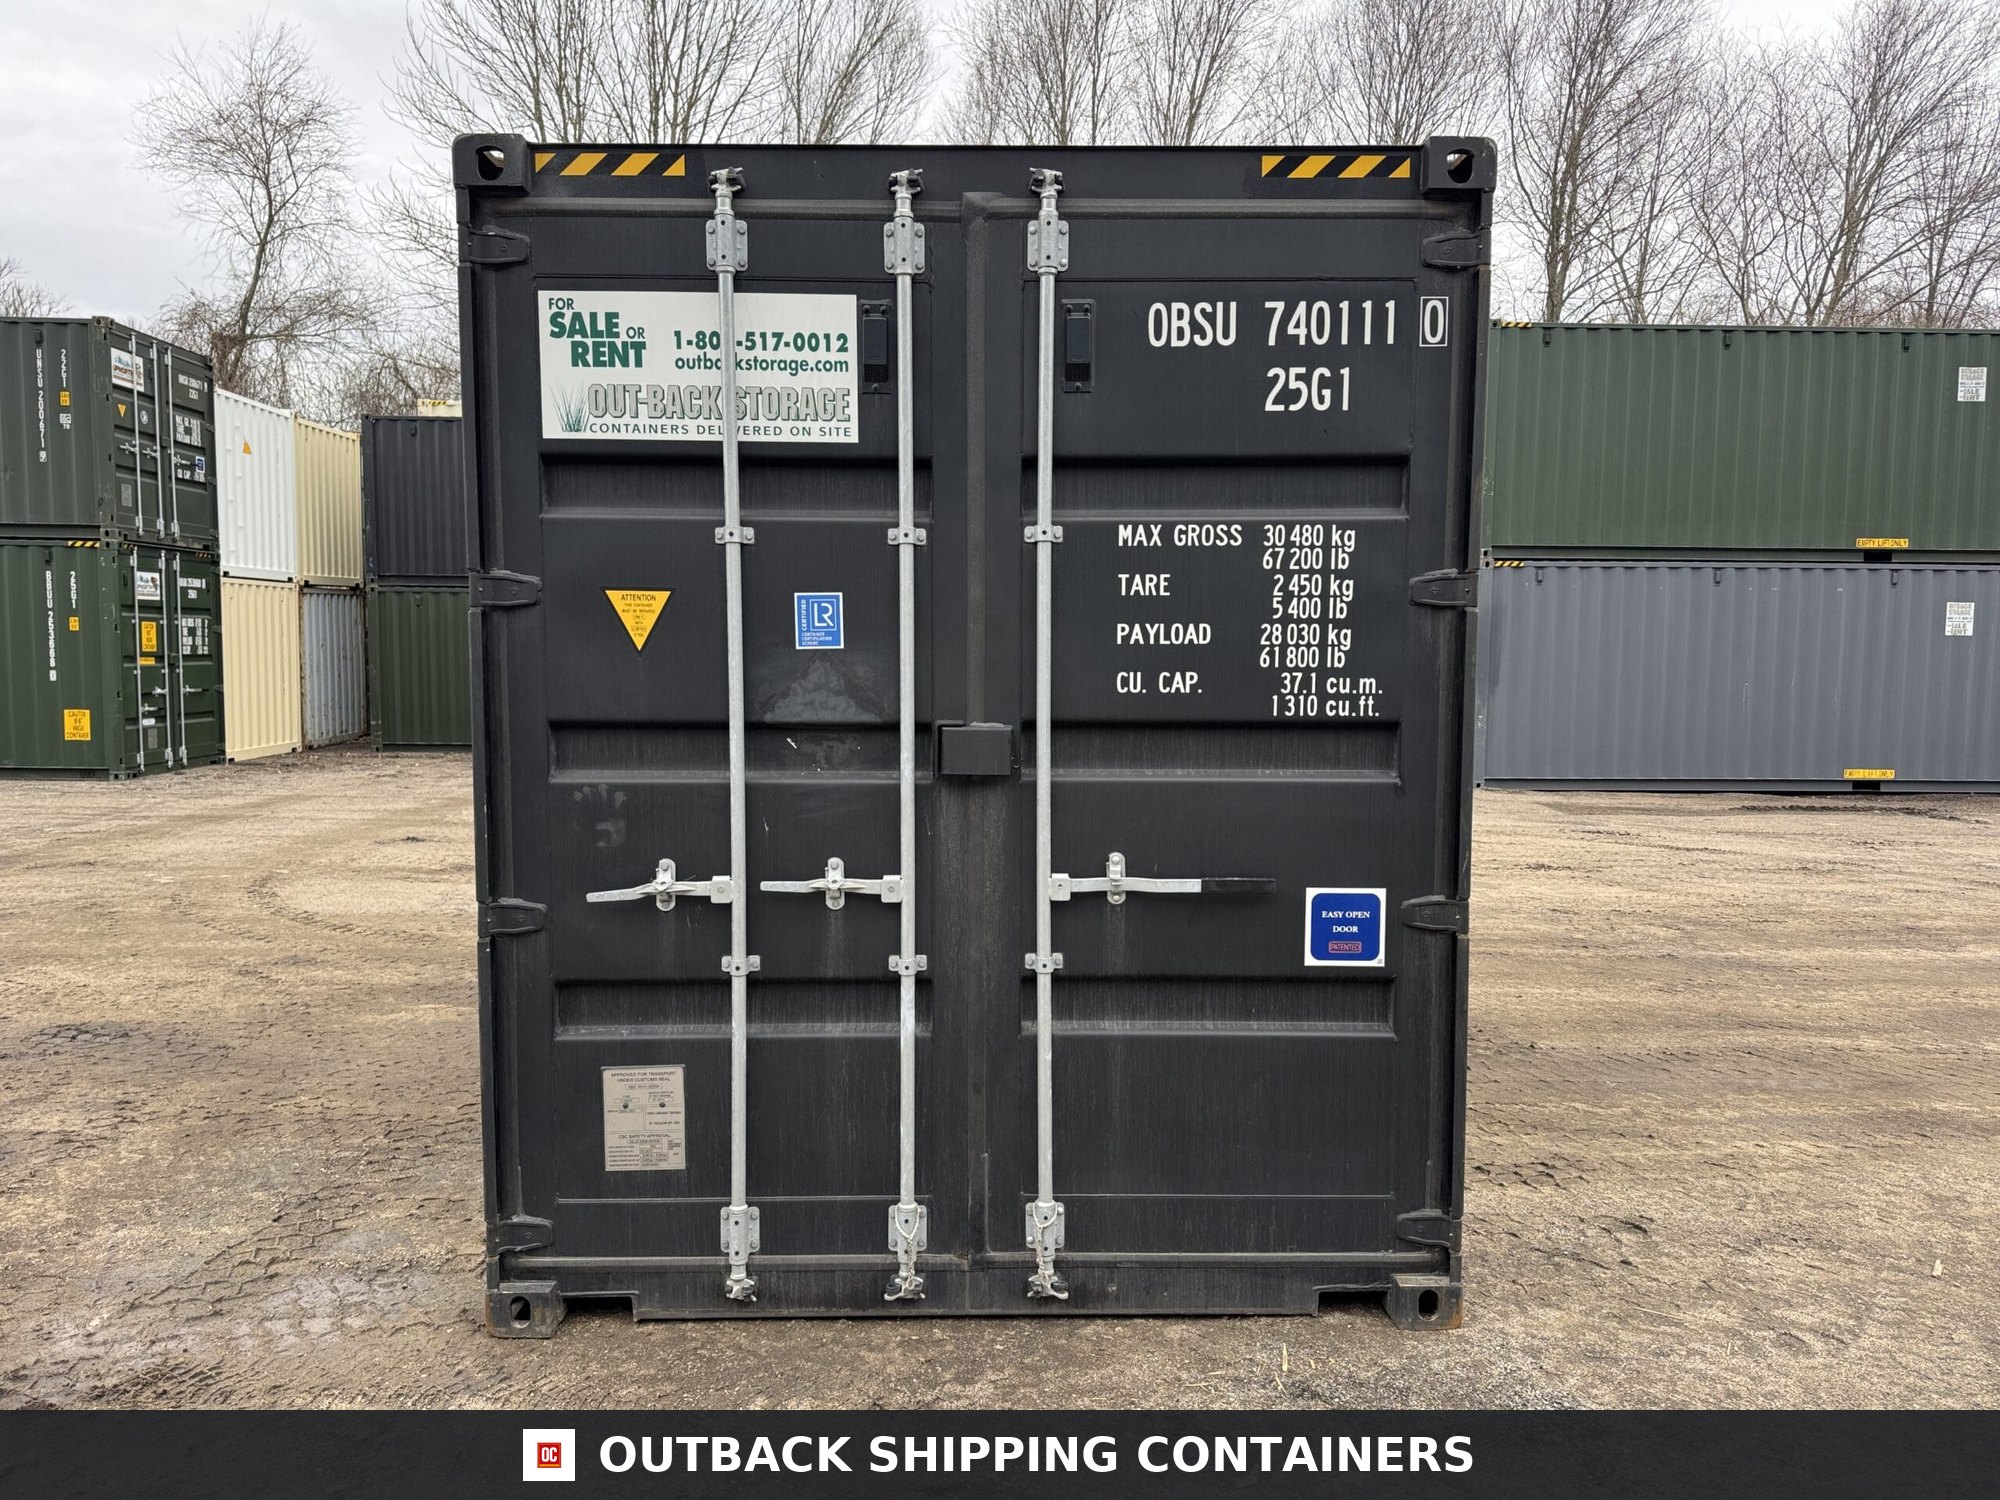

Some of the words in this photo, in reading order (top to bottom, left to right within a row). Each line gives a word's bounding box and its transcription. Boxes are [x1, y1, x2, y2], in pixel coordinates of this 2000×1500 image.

[548, 298, 574, 310] FOR
[548, 312, 620, 339] SALE
[626, 326, 646, 340] OR
[1147, 301, 1237, 348] OBSU
[1264, 300, 1396, 346] 740111
[1424, 299, 1446, 344] 0
[570, 340, 646, 368] RENT
[673, 330, 849, 354] 1-80-517-0012
[674, 352, 849, 376] outbakstorage.com
[1264, 366, 1350, 412] 25G1
[734, 386, 852, 422] STORAGE
[589, 422, 688, 435] CONTAINERS
[697, 424, 783, 437] DELERED
[790, 425, 812, 437] ON
[819, 425, 852, 438] SITE
[1118, 524, 1162, 546] MAX
[1174, 524, 1243, 546] GROSS
[1330, 524, 1356, 551] kg
[1330, 548, 1350, 569] lb
[1118, 574, 1171, 596] TARE
[1330, 574, 1354, 601] kg
[814, 602, 834, 627] LR
[1329, 597, 1348, 619] lb
[1116, 624, 1211, 645] PAYLOAD
[1328, 624, 1352, 651] kg
[1327, 647, 1346, 668] lb
[1116, 672, 1147, 694] CU.
[1158, 672, 1202, 694] CAP.
[1280, 672, 1317, 694] 37.1
[1326, 676, 1383, 694] cu.m.
[1325, 695, 1380, 717] cu.ft.
